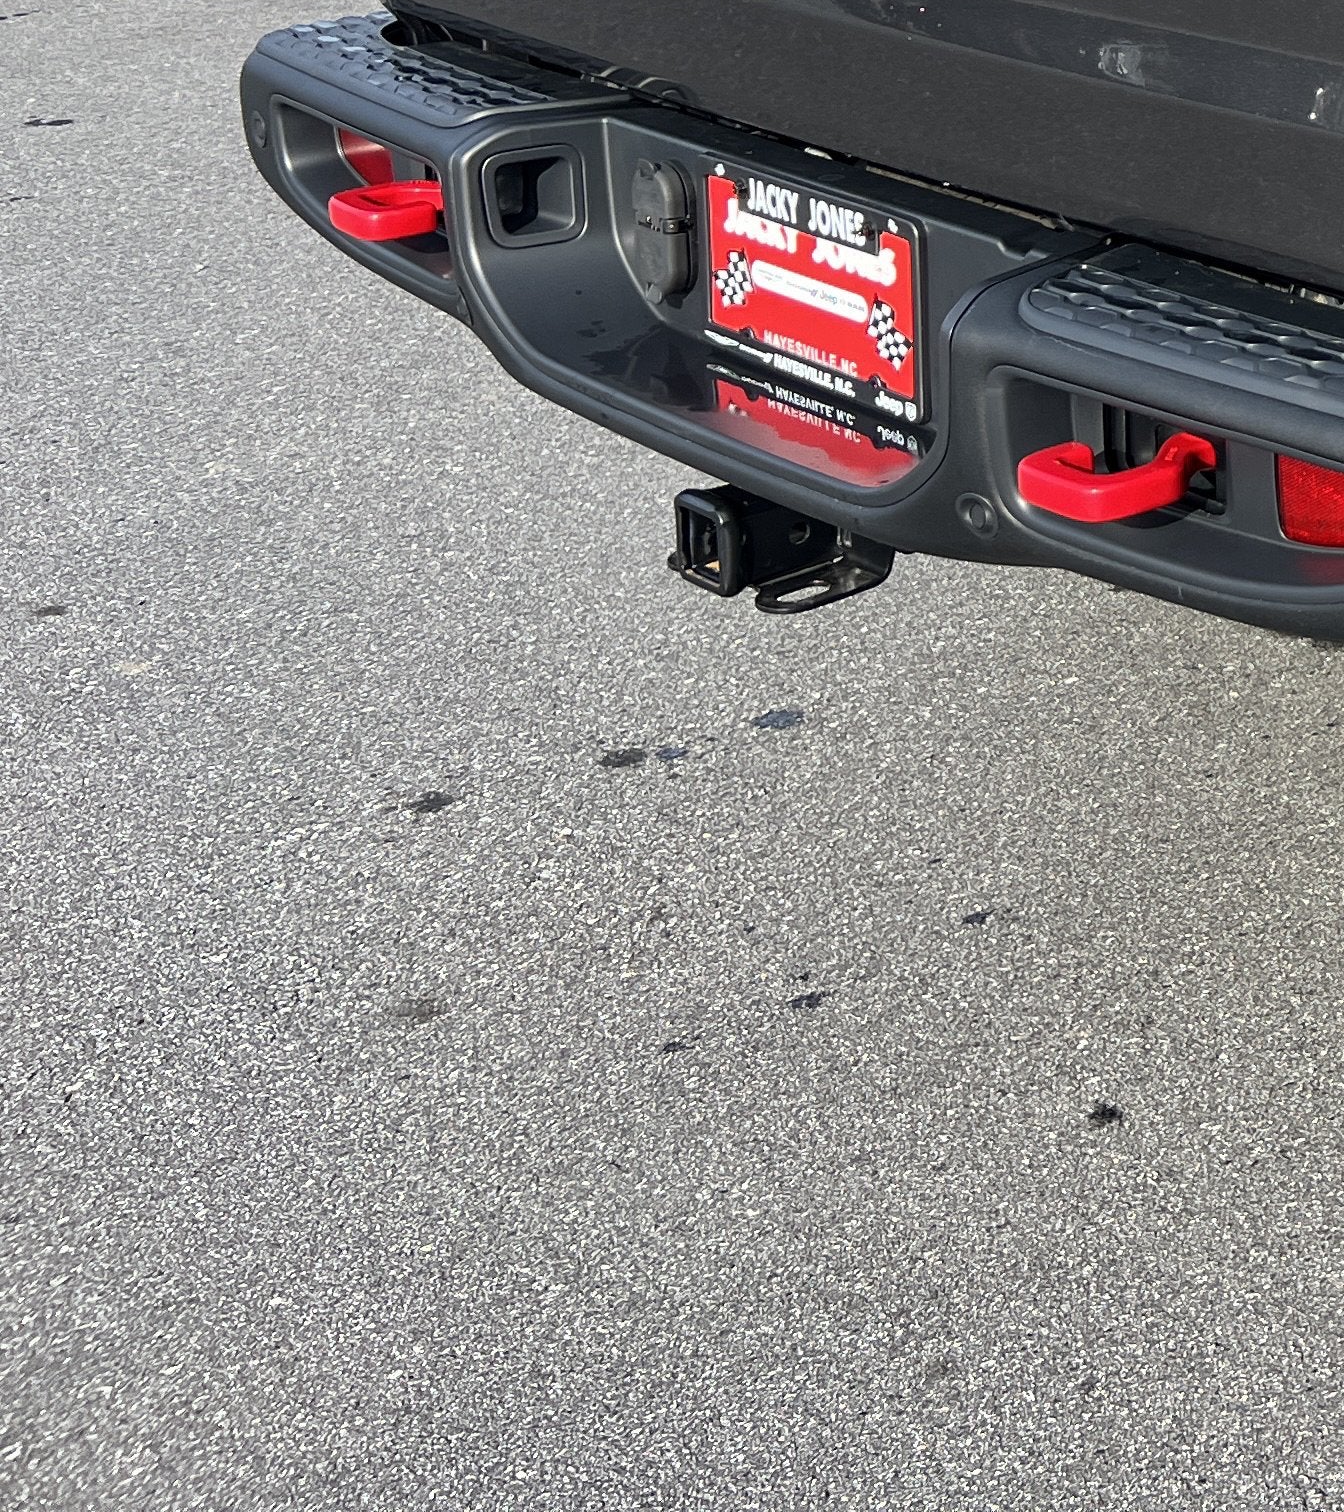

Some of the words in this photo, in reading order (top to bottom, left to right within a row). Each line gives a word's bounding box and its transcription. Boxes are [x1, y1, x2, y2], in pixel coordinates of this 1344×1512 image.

[747, 177, 799, 225] JACKY
[808, 197, 866, 247] JONES
[874, 390, 904, 416] Jeep
